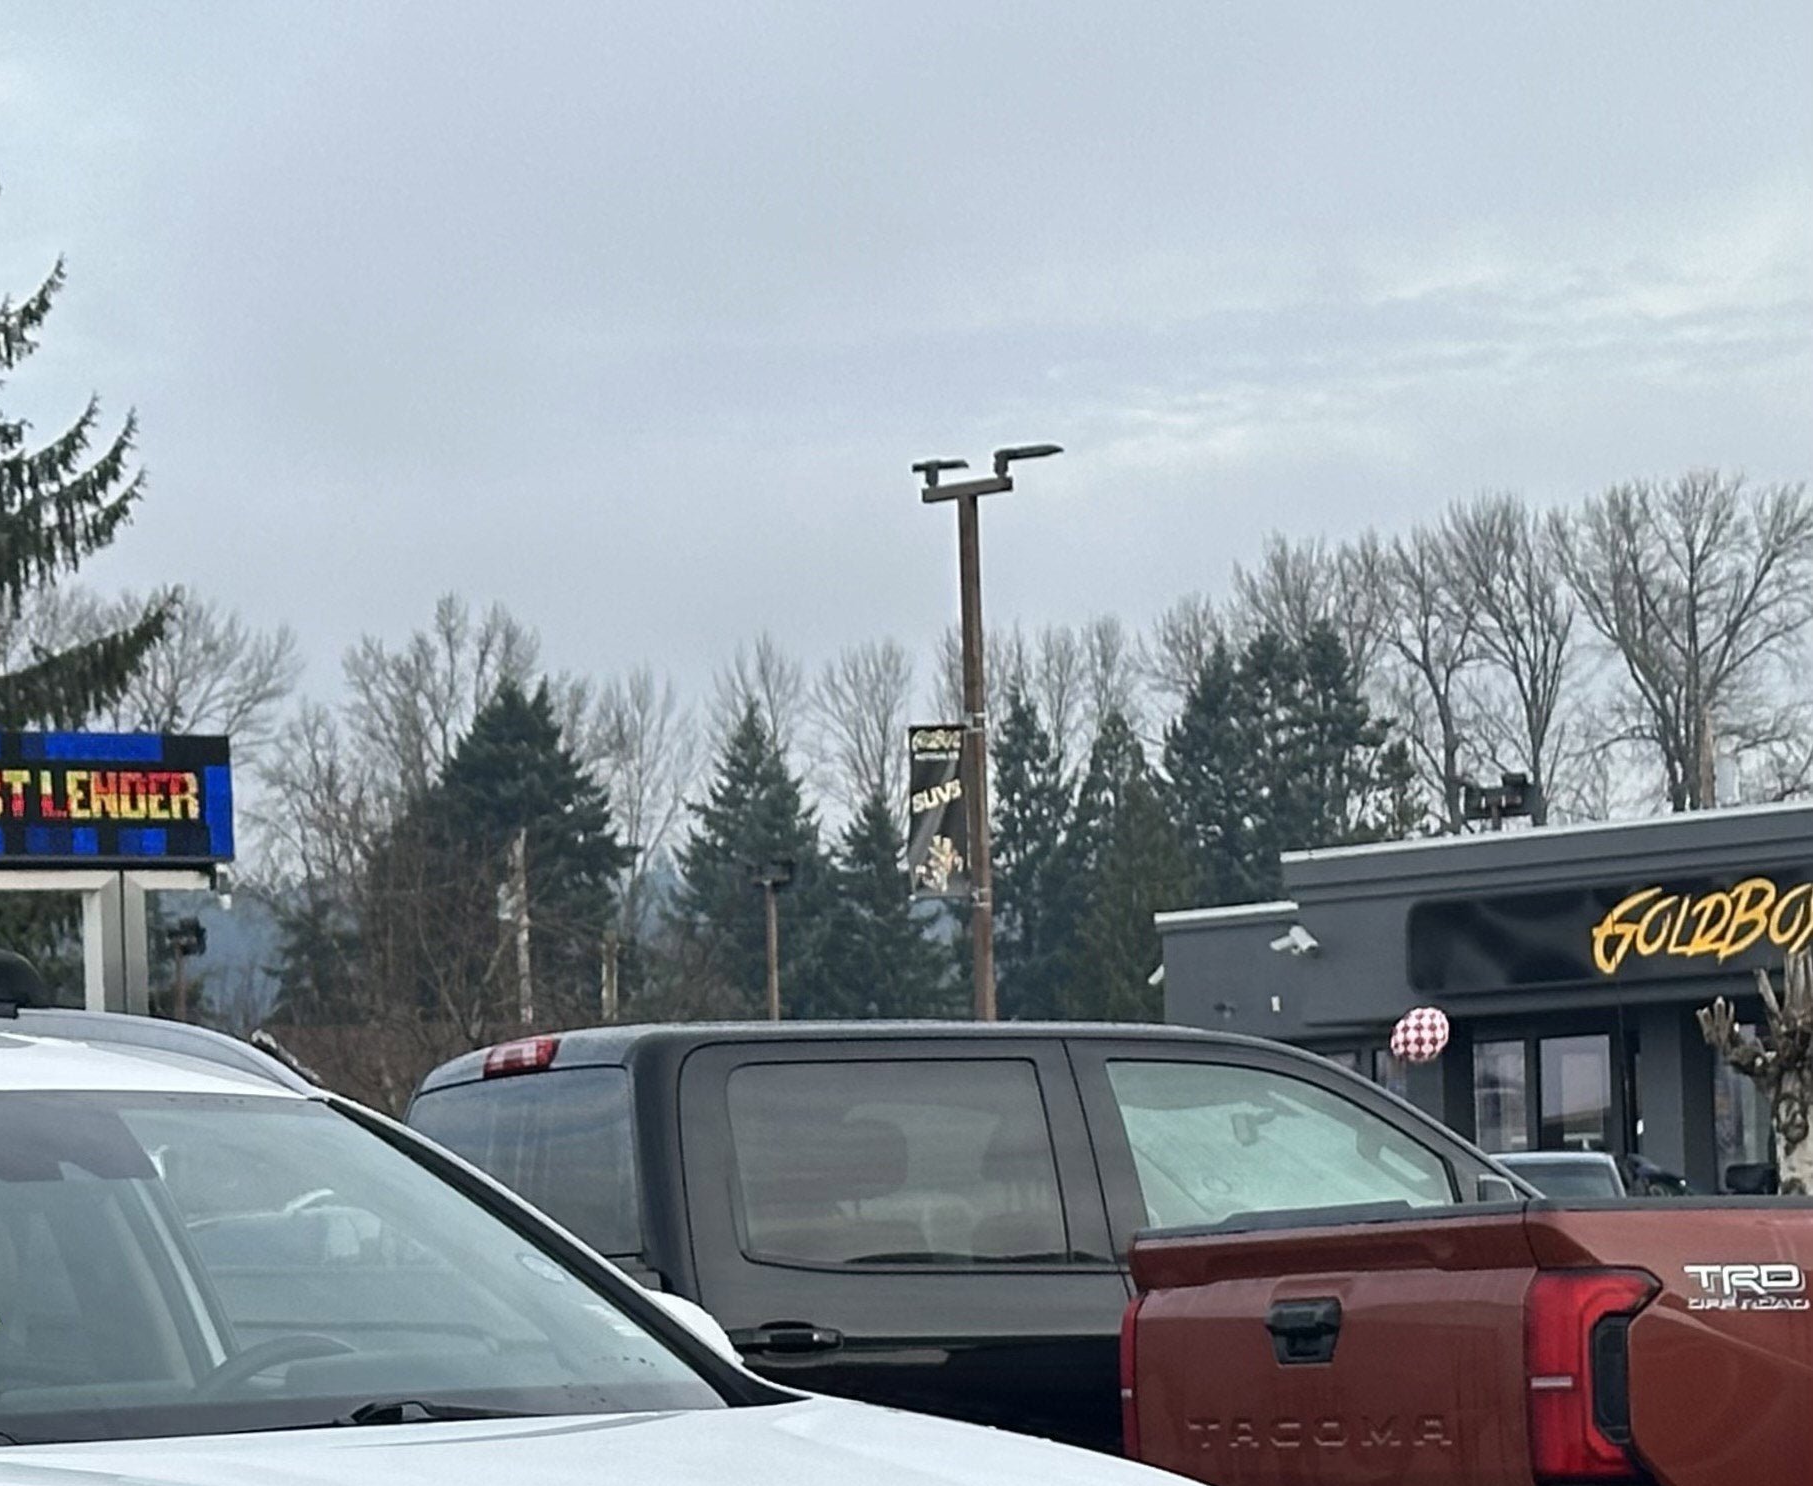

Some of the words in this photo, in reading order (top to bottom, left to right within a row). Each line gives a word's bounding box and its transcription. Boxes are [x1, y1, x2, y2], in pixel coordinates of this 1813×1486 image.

[40, 770, 200, 820] LENDER
[1683, 1264, 1806, 1295] TRD
[1187, 1415, 1453, 1448] TACOMA
